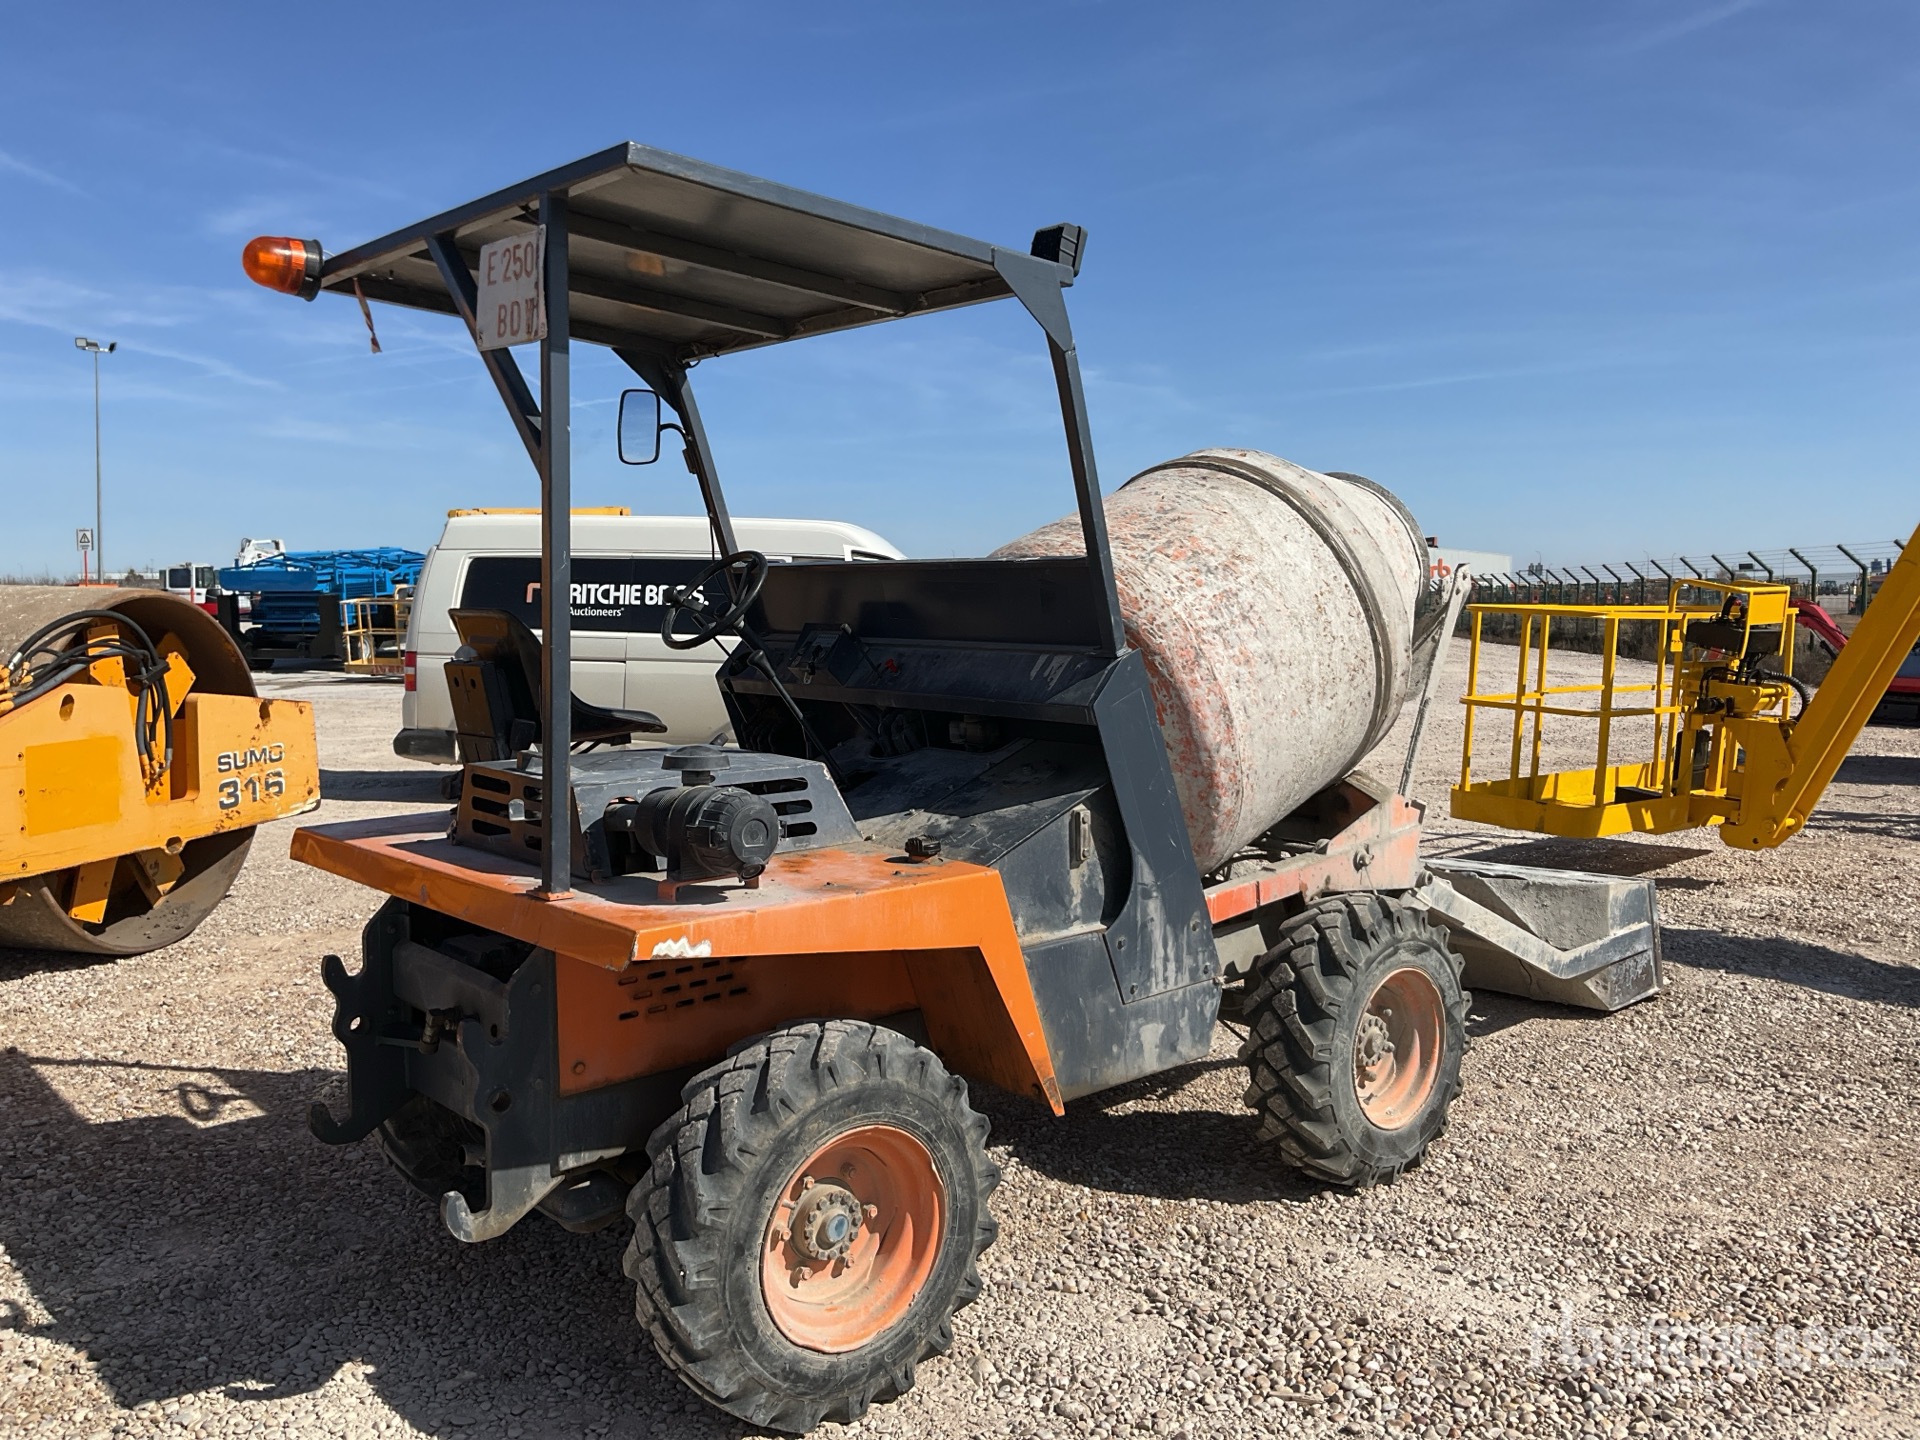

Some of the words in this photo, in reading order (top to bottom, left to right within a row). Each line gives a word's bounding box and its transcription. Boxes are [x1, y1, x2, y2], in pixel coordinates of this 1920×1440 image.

[487, 251, 498, 286] E
[569, 583, 642, 606] RITCHIE
[217, 743, 284, 773] SUMO
[218, 768, 286, 810] 316
